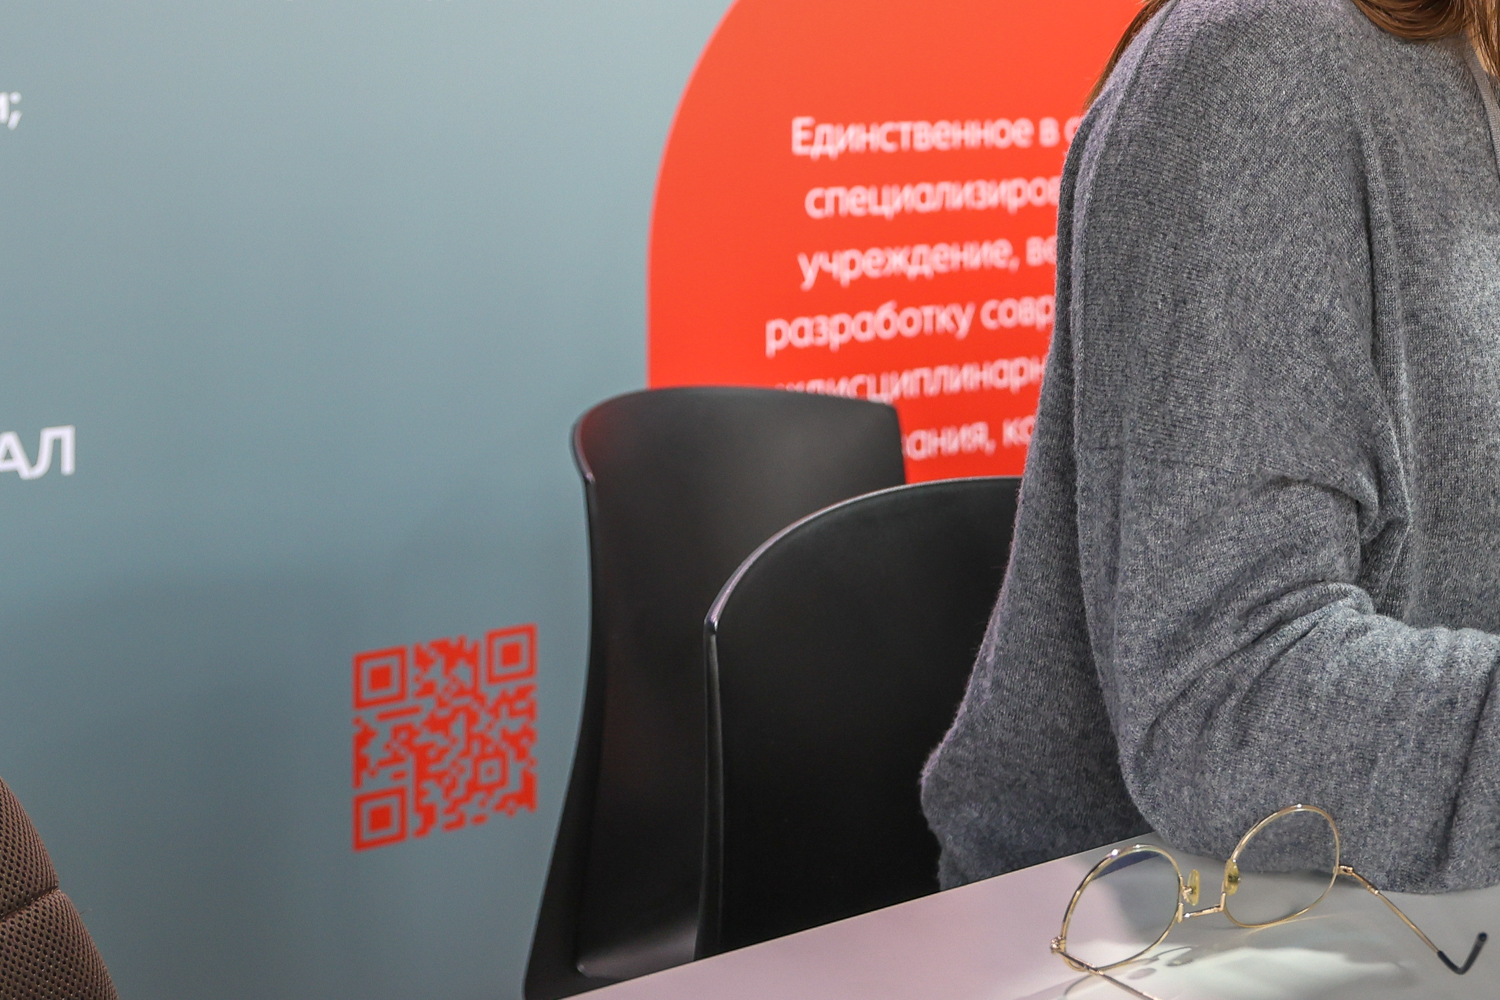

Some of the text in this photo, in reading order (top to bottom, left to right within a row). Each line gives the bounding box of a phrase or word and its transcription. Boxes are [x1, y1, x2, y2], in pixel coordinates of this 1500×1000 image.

[791, 116, 1035, 160] Единственное
[1039, 117, 1060, 147] в
[798, 238, 1020, 291] учреждение,
[766, 300, 975, 358] разработку
[903, 421, 995, 460] ания,
